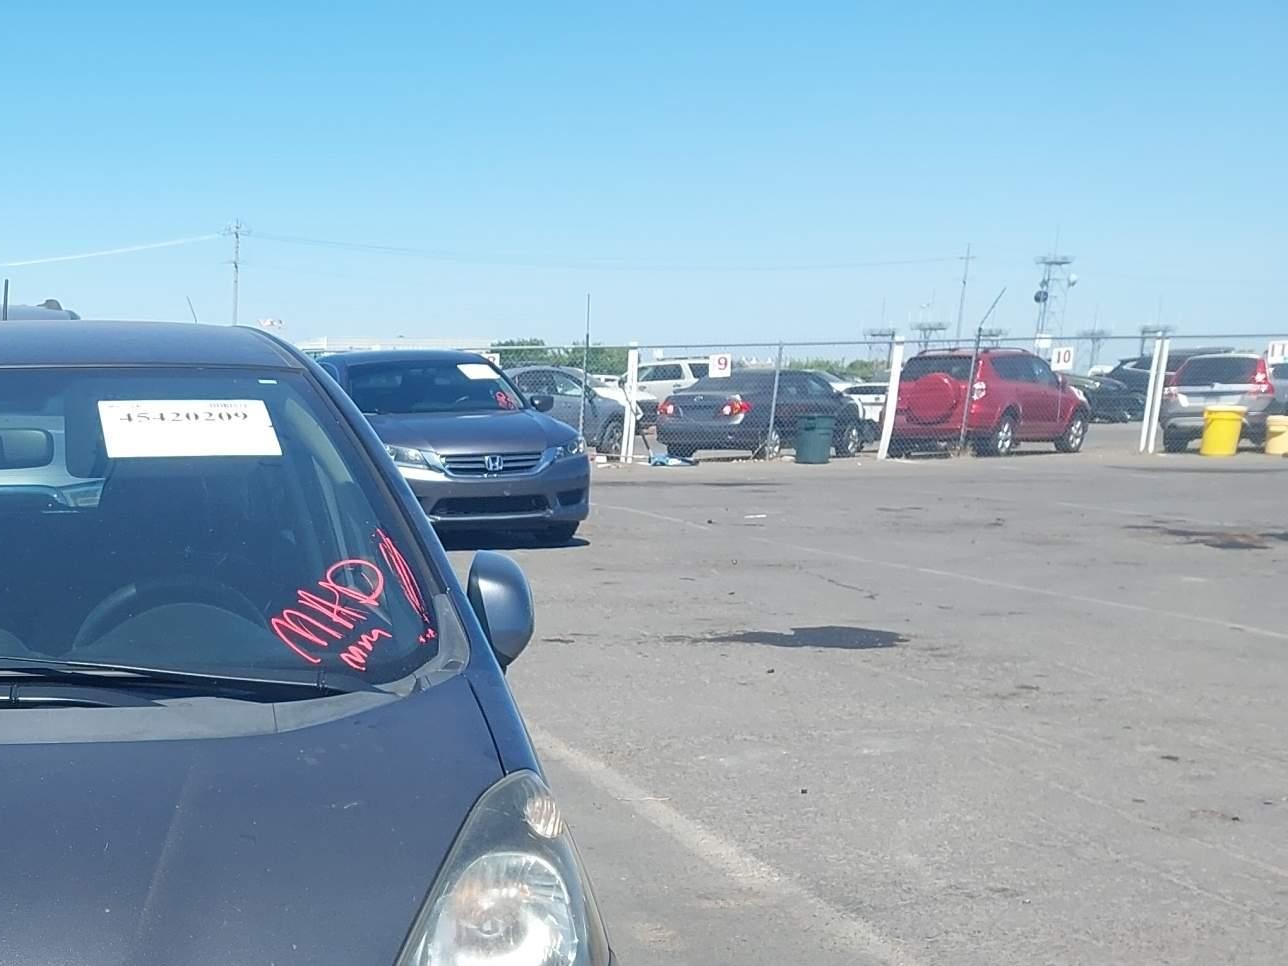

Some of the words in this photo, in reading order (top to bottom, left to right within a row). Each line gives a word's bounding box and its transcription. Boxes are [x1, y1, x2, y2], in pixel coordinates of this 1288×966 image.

[717, 356, 728, 370] 9
[1056, 350, 1071, 364] 10
[119, 410, 249, 424] 45420209
